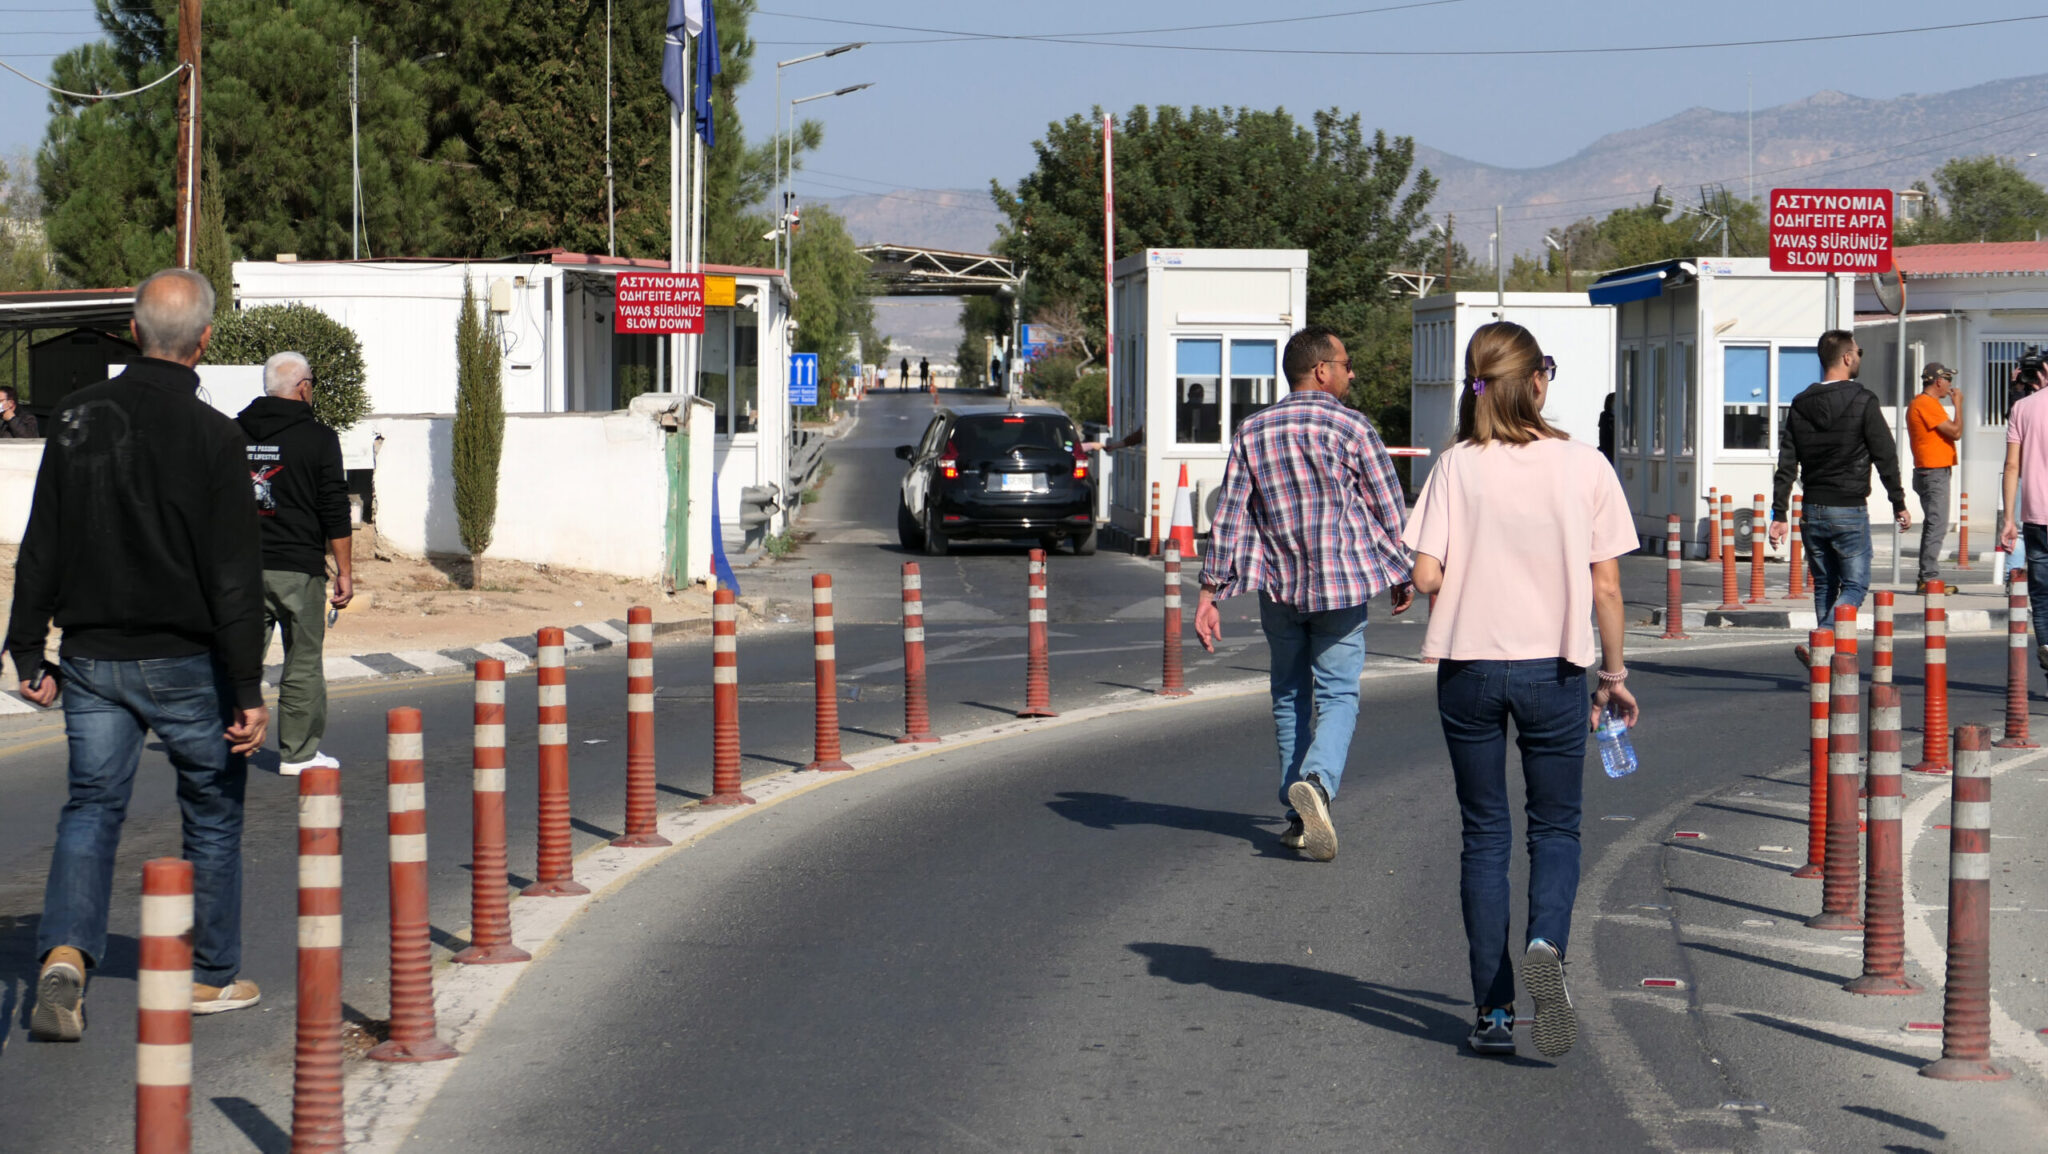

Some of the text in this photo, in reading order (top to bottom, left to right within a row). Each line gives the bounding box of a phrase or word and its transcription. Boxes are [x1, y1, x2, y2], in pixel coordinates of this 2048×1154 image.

[1776, 195, 1886, 210] ΑΣΤΥΝΟΜΙΑ
[1774, 214, 1886, 228] ΟΔΗΓΕΙΤΕ ΑΡΓΑ
[1773, 233, 1888, 250] YAVAŞ SÜRÜNÜZ
[1787, 251, 1878, 267] SLOW DOWN
[620, 277, 699, 288] ΑΣΤΥΝΟΜΙΑ
[620, 291, 671, 301] ΟΔΗΓΕΙΤΕ
[674, 291, 701, 301] ΑΡΓΑ
[619, 304, 702, 317] YAVAŞ SÜRÜNÜZ
[626, 318, 691, 329] SLOW DOWN
